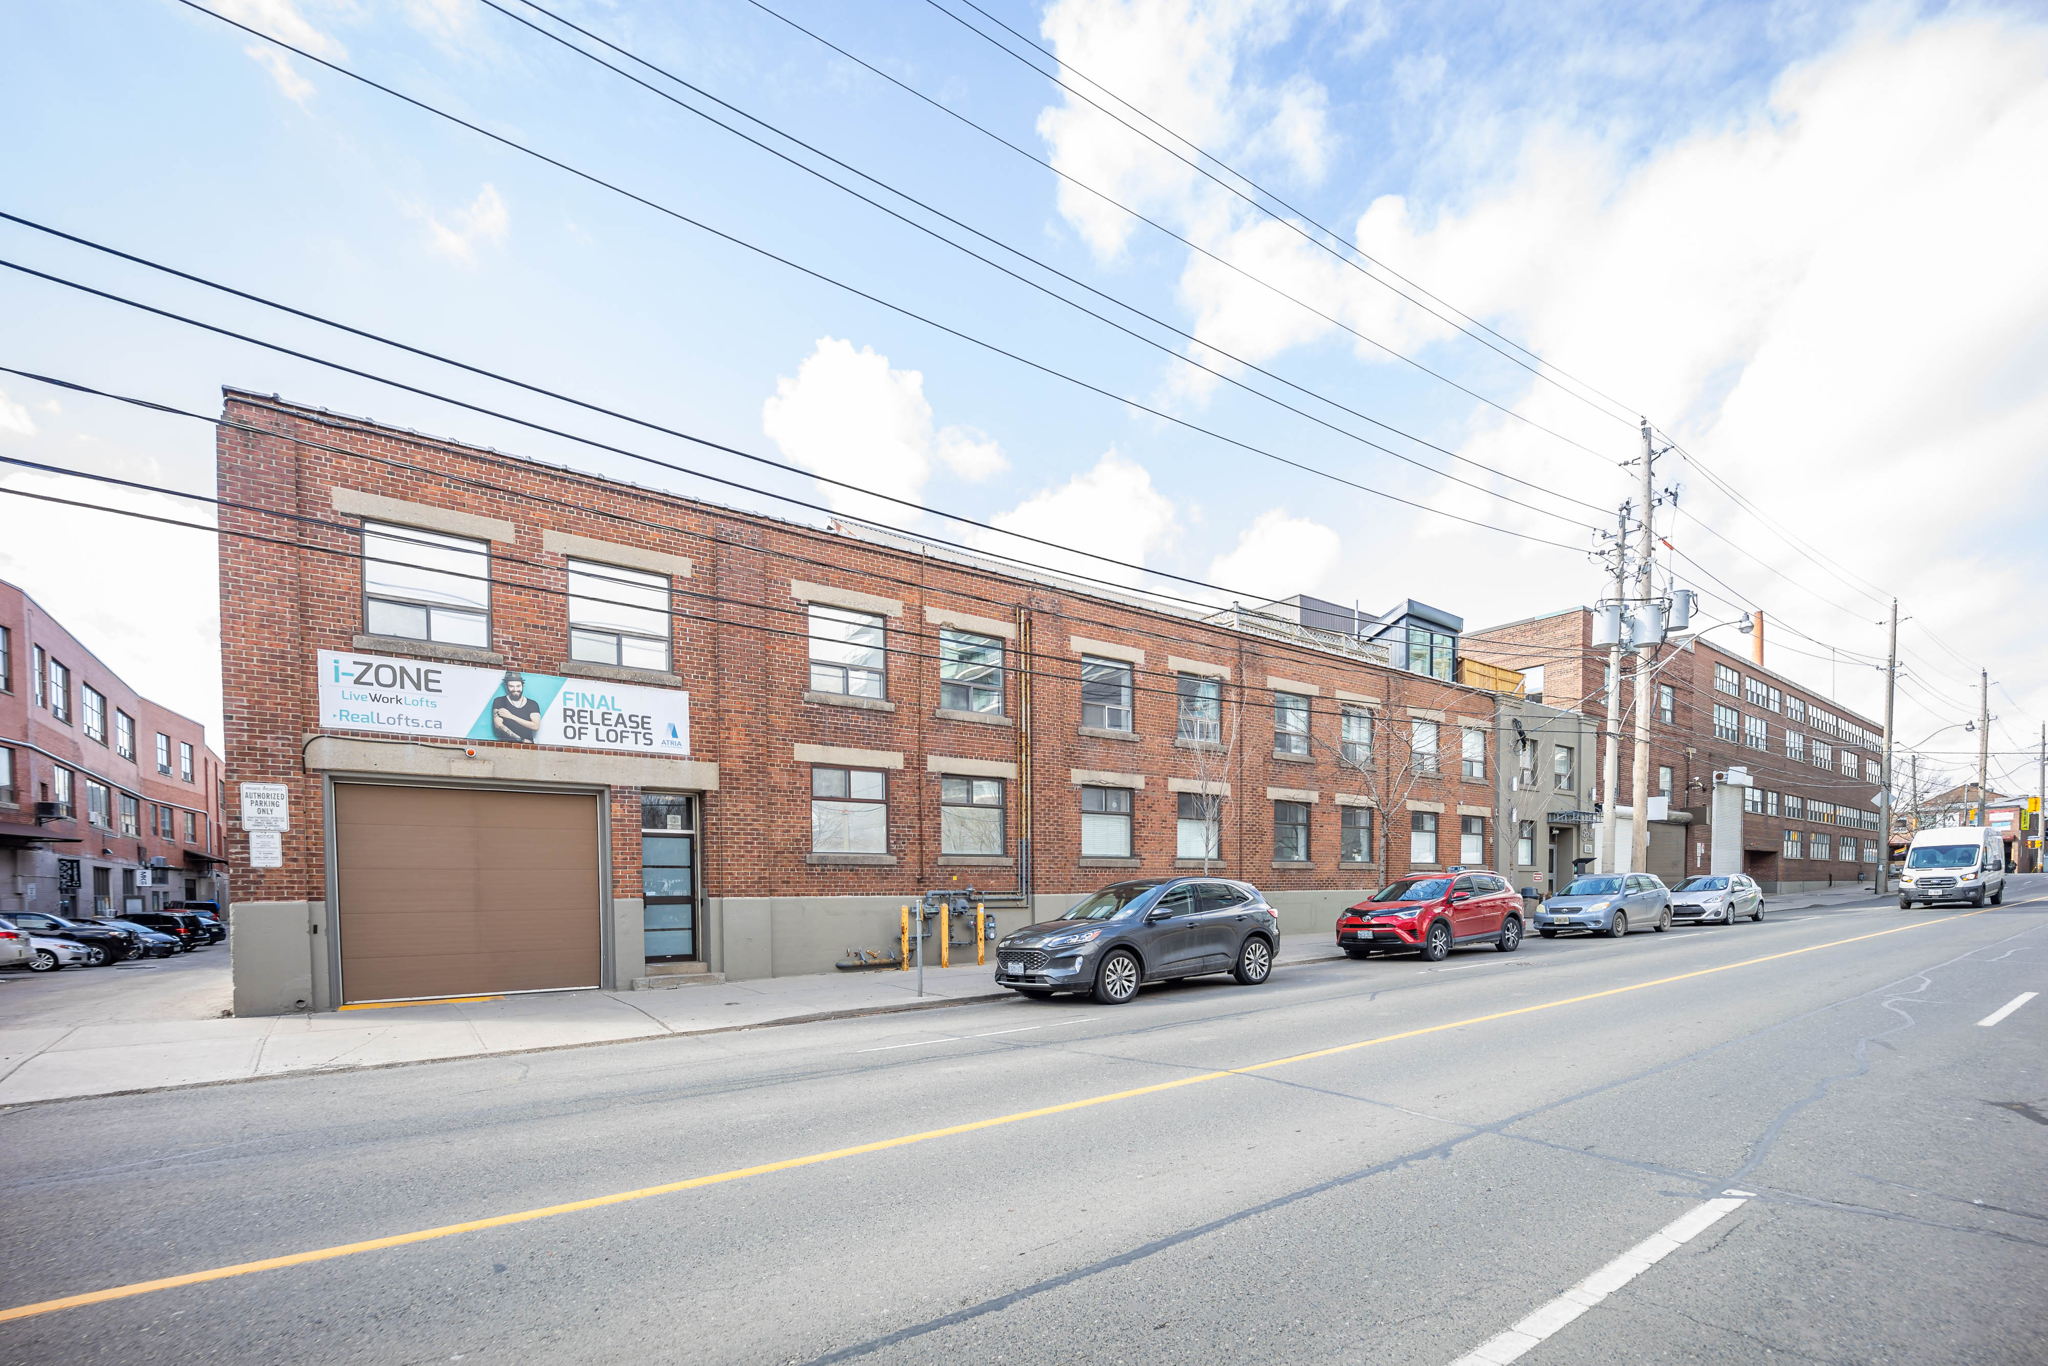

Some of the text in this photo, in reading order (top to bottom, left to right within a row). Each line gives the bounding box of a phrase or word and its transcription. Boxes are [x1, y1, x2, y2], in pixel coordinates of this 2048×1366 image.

[333, 659, 443, 693] i-ZONE
[562, 691, 622, 712] FINAL
[563, 707, 652, 731] RELEASE
[563, 725, 654, 746] OF LOFTS
[661, 739, 682, 747] ATRIA
[244, 791, 285, 800] AUTHORIZED
[250, 799, 280, 808] PARKING
[256, 807, 274, 815] ONLY
